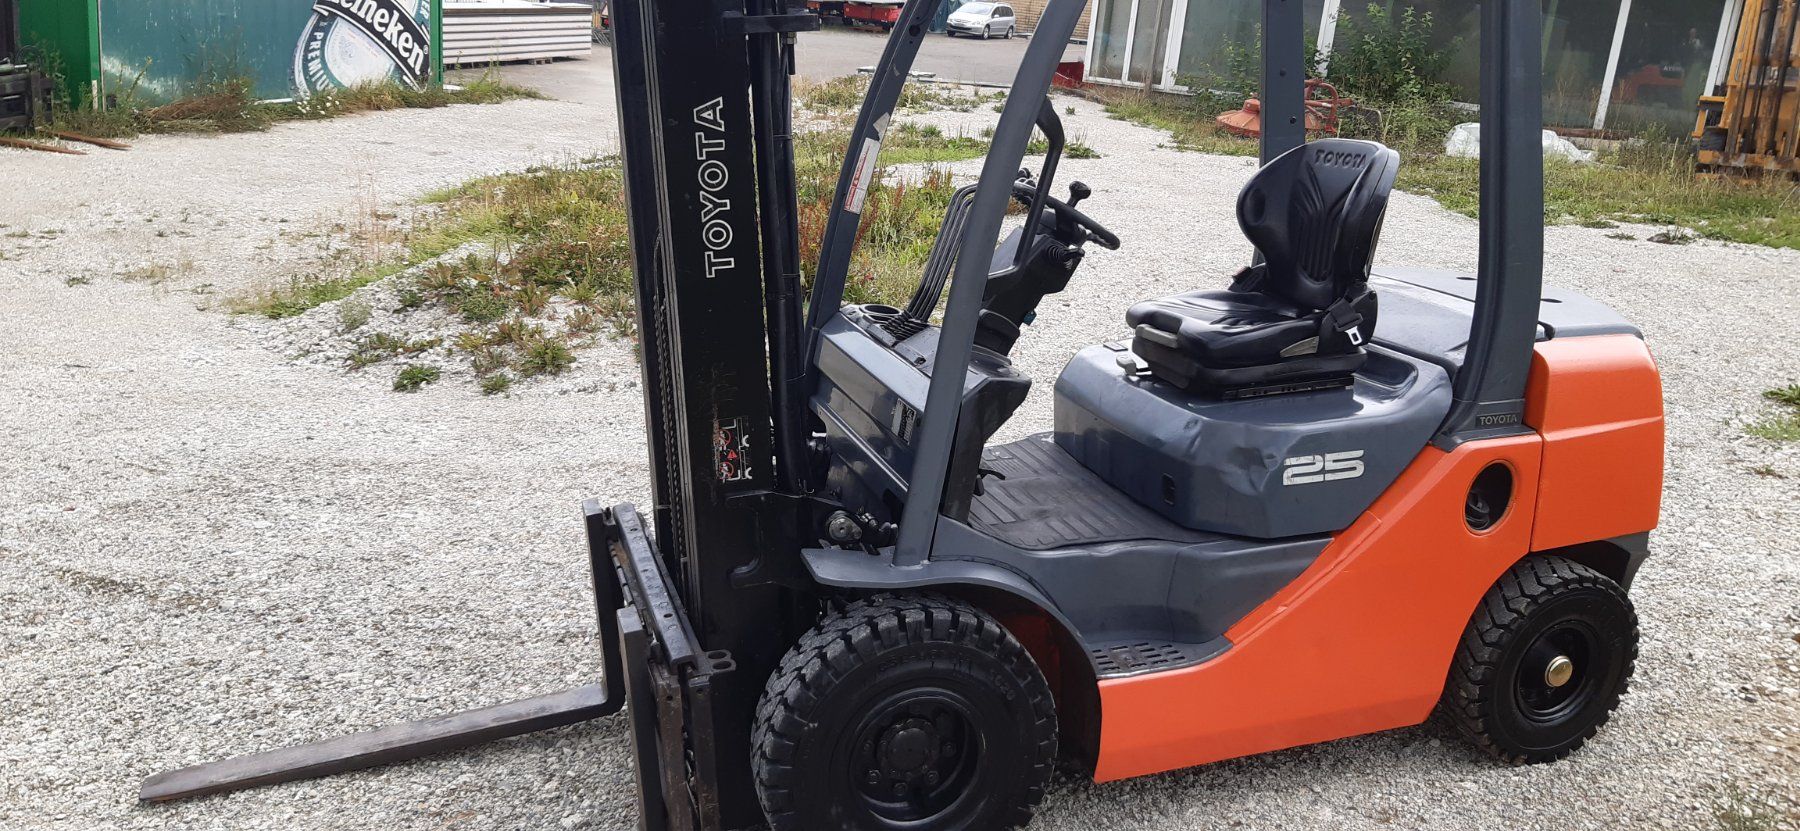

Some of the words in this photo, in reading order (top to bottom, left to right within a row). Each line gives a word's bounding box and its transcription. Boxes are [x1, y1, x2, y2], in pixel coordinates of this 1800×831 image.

[327, 0, 424, 75] ineken
[307, 32, 335, 93] PREMIU
[1314, 149, 1367, 169] TOYOTA
[693, 96, 735, 278] TOYOTA
[1479, 414, 1518, 426] TOYOTA
[1282, 449, 1365, 486] 25
